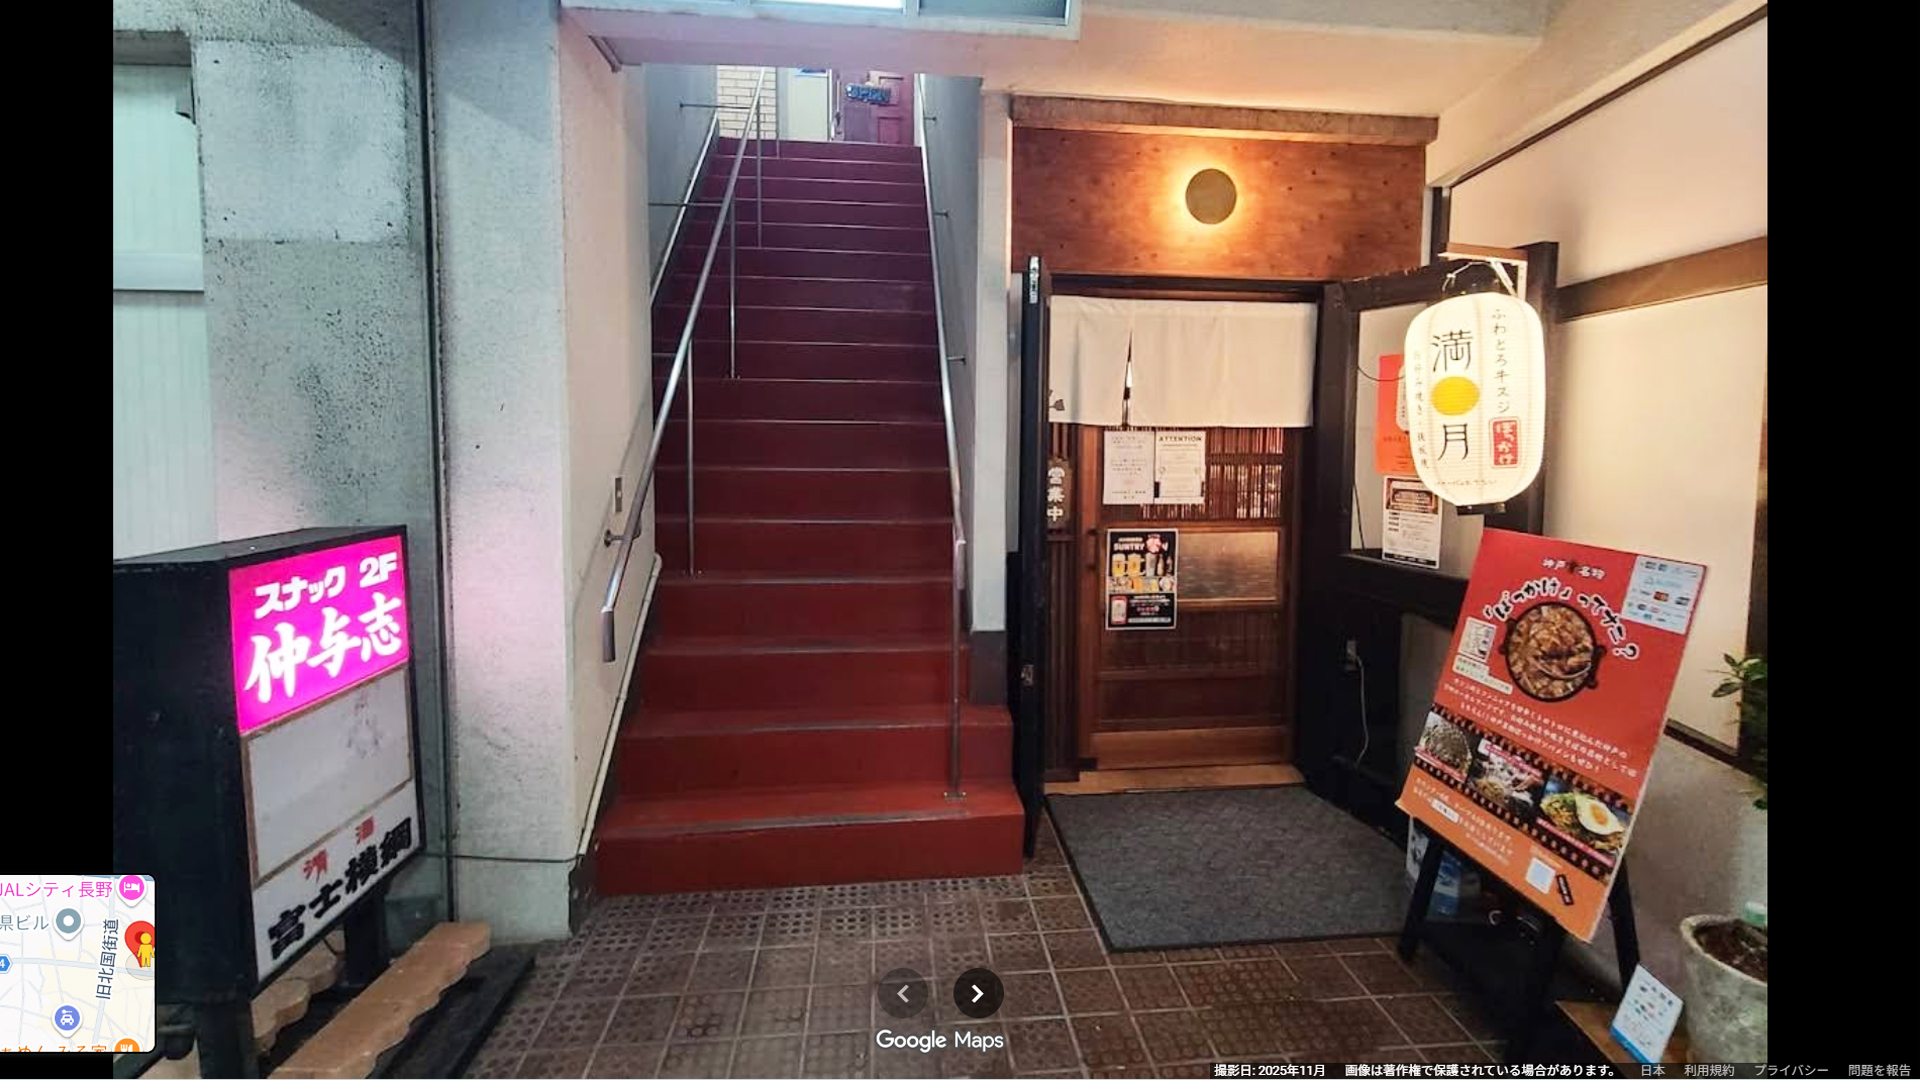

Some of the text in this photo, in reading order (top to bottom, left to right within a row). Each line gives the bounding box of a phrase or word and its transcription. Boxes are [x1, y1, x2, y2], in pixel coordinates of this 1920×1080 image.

[1431, 330, 1473, 461] 満月
[1494, 421, 1517, 466] ぼっかけ
[1046, 466, 1065, 522] 営業中
[254, 552, 397, 620] スナック 2F
[244, 591, 402, 704] 仲与志
